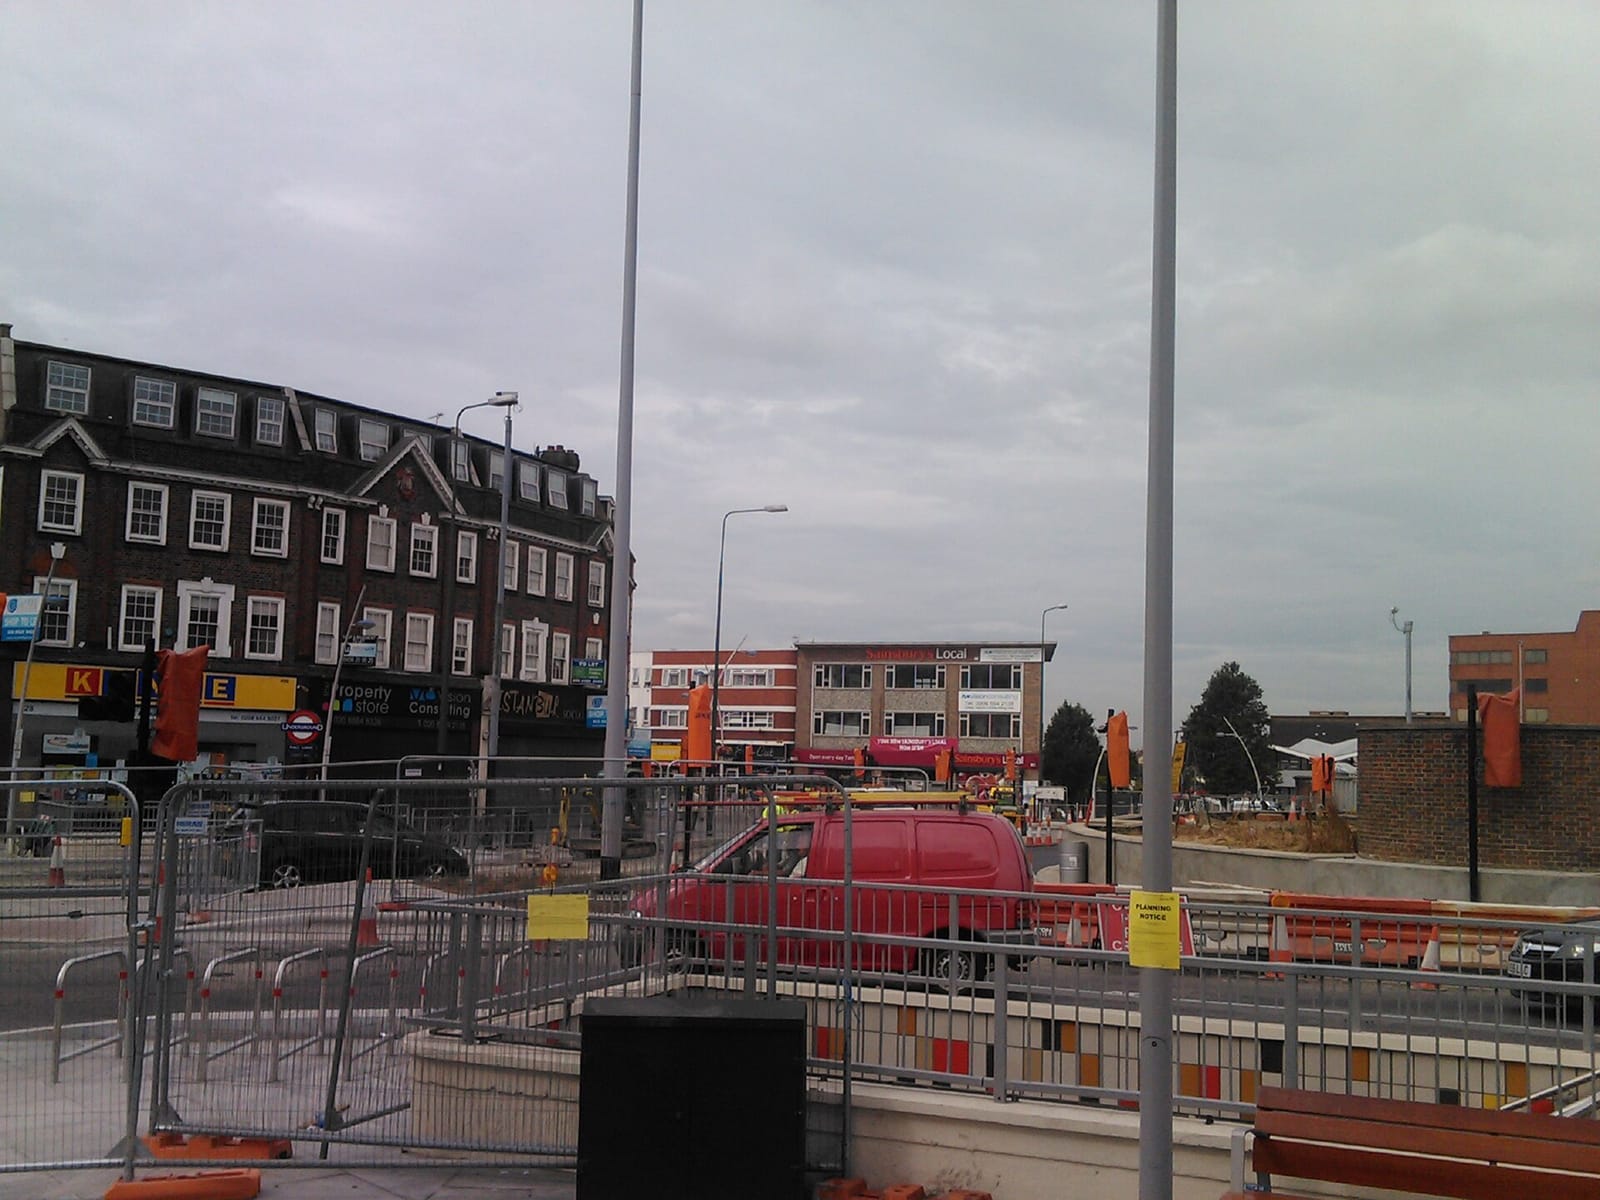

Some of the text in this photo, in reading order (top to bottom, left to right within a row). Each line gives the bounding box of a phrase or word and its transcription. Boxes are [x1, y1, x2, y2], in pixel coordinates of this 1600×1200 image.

[935, 648, 966, 659] Local
[355, 699, 389, 714] store
[408, 701, 470, 719] Consting
[282, 723, 323, 732] UNDERGROUND
[1135, 903, 1171, 911] PLANNING
